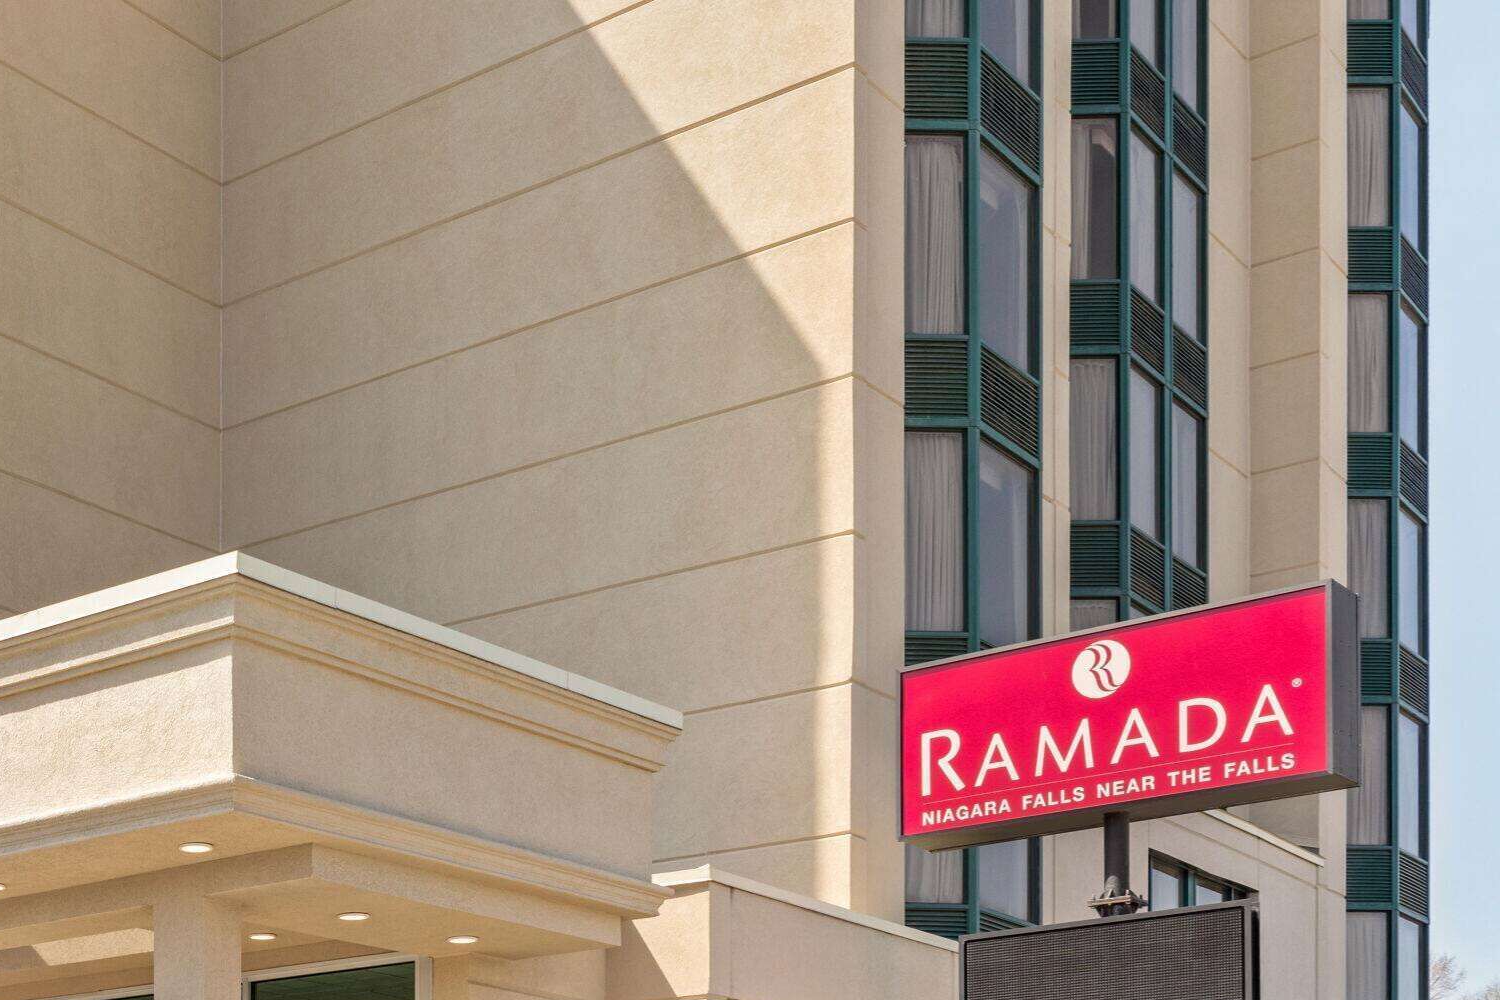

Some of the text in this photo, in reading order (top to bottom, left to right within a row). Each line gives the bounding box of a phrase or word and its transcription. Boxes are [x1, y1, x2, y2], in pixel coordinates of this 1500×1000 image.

[920, 683, 1294, 797] RAMADA
[921, 752, 1296, 827] NIAGARA FALLS NEAR THE FALLS
